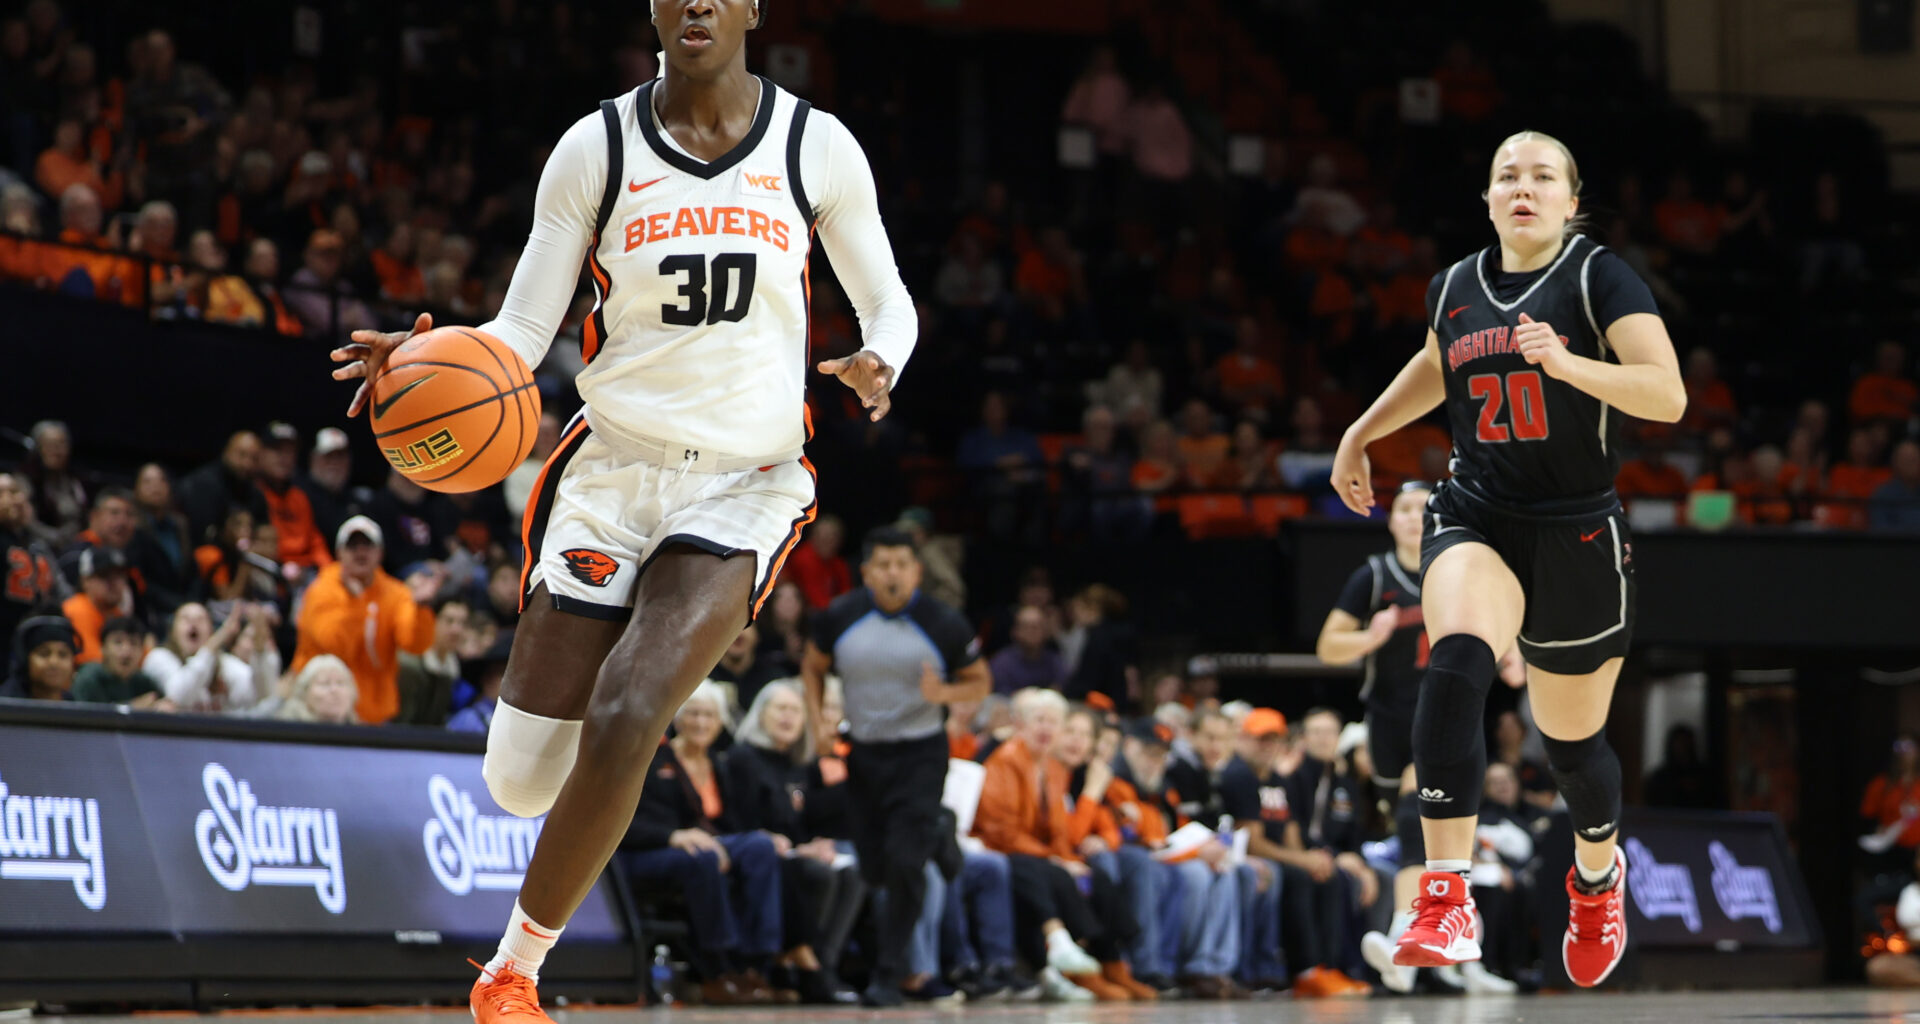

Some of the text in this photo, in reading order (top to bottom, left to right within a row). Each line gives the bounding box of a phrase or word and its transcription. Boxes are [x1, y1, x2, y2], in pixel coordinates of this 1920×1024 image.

[743, 172, 783, 191] WCC
[624, 206, 790, 253] BEAVERS
[658, 252, 757, 326] 30
[1447, 325, 1569, 372] NIGHTHA
[1467, 369, 1549, 443] 20
[383, 427, 460, 468] ELITE
[0, 776, 107, 911] tarry
[194, 762, 346, 914] Starry
[422, 773, 547, 896] Starr
